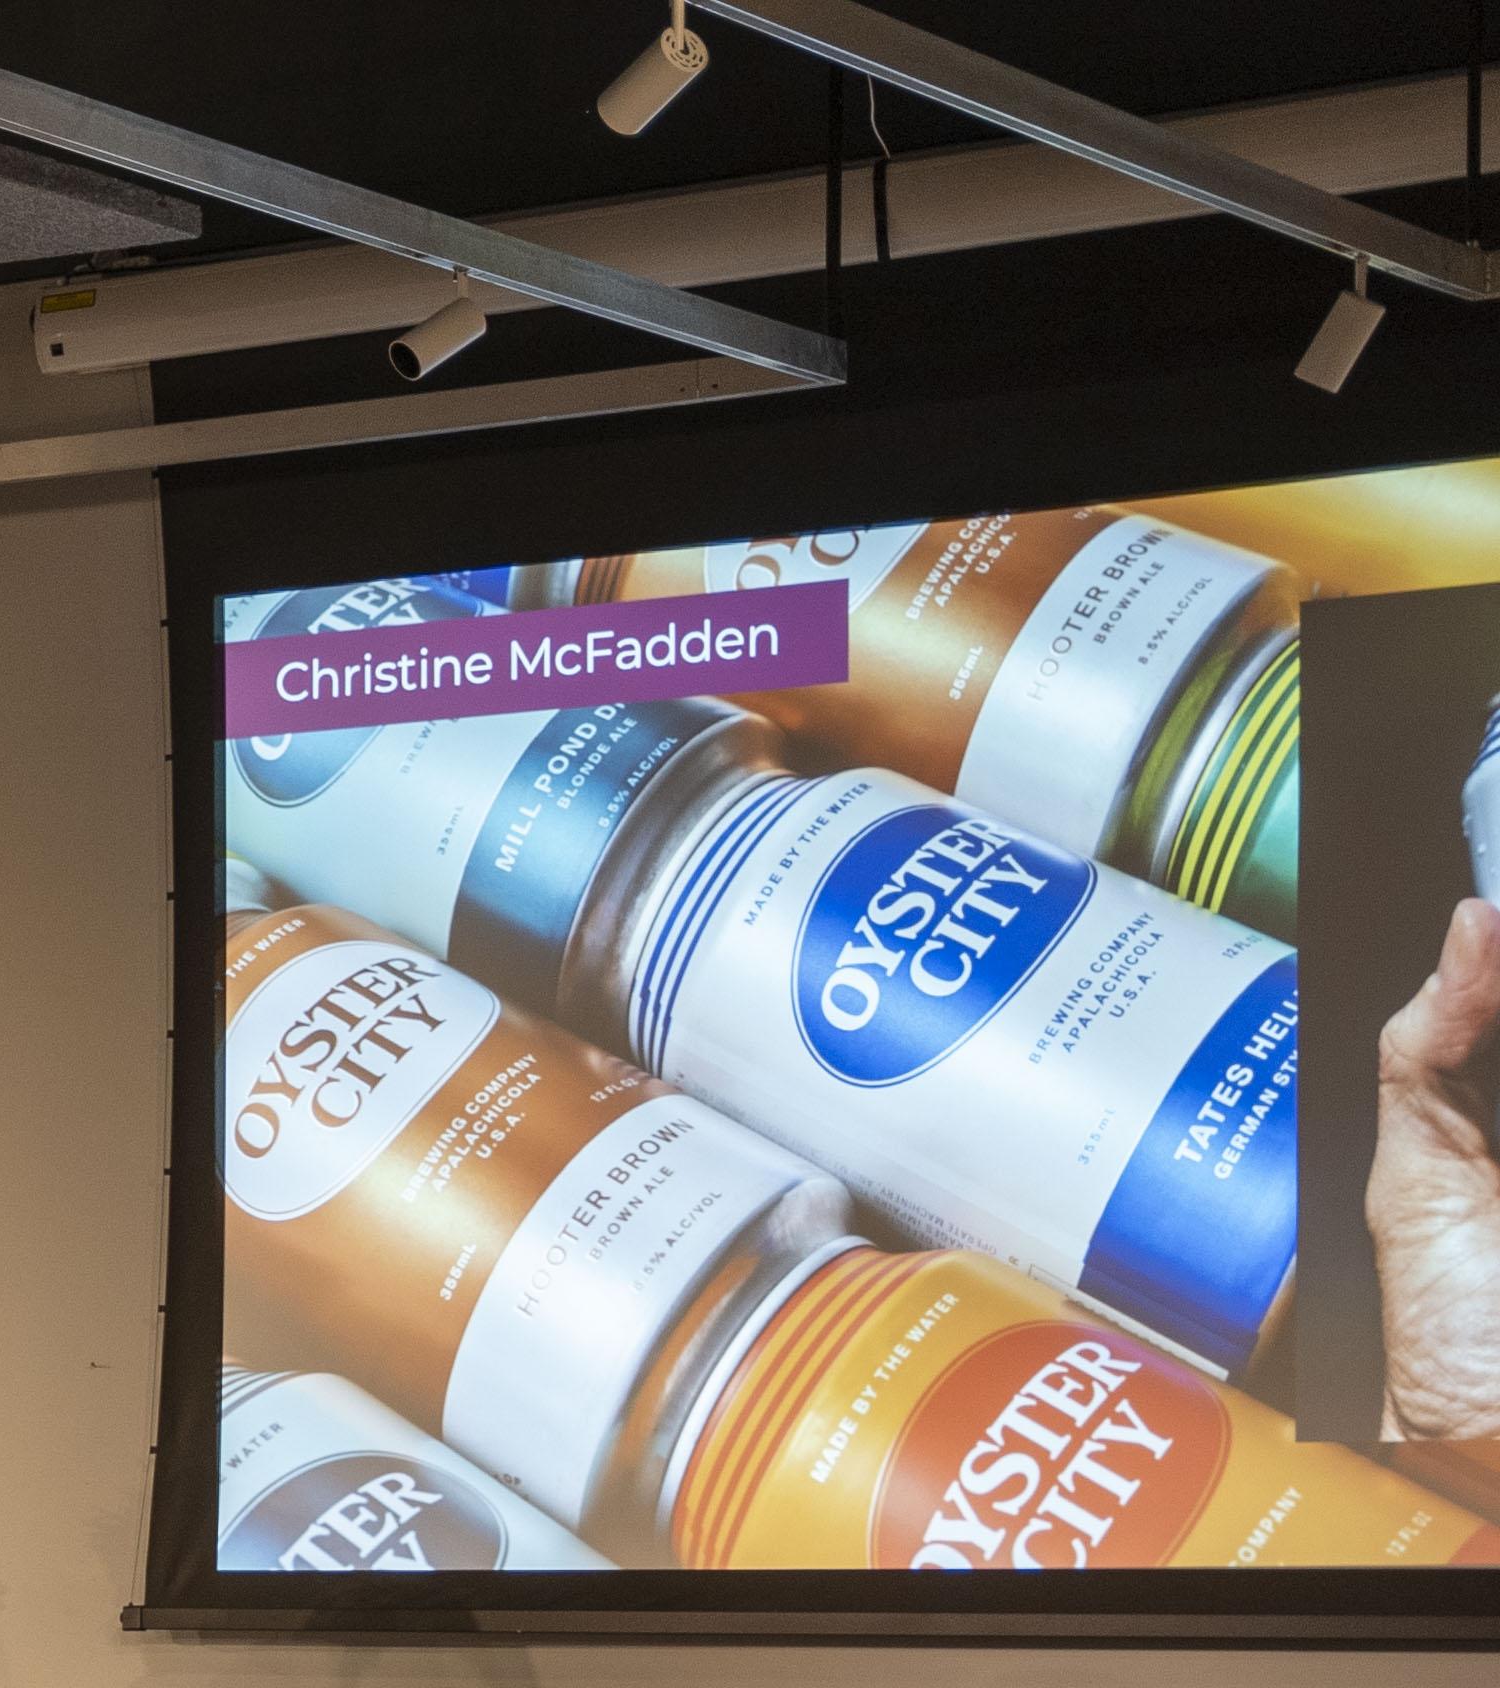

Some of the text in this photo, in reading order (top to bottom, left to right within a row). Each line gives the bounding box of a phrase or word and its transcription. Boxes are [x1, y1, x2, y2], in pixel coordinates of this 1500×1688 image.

[308, 578, 431, 635] TER
[1026, 528, 1174, 702] HOOTER BROWN
[1093, 560, 1166, 645] BROWN ALE
[276, 619, 780, 702] Christine McFadden
[495, 801, 542, 872] MILL
[534, 722, 597, 794] POND
[556, 716, 639, 810] BLONDE ALE
[627, 735, 680, 788] ALC/VOL
[743, 781, 873, 927] MADE BY THE WATER
[226, 918, 306, 979] THE WATER
[821, 817, 1014, 1032] OYSTER
[909, 853, 1049, 997] CITY
[1028, 911, 1155, 1066] BREWING COMPANY
[1061, 930, 1164, 1055] APALACHICOLA
[1109, 968, 1157, 1019] U.S.A.
[234, 957, 443, 1159] OYSTER
[311, 993, 447, 1128] CITY
[401, 1053, 538, 1204] BREWING COMPANY
[431, 1072, 541, 1194] APALACHICOLA
[475, 1111, 527, 1160] U.S.A.
[1173, 1063, 1255, 1163] TATES
[1213, 1087, 1280, 1179] GERMAN
[516, 1118, 695, 1319] HOOTER BROWN
[588, 1165, 675, 1262] BROWN ALE
[666, 1190, 723, 1248] ALC/VOL
[810, 1416, 859, 1484] MADE
[851, 1385, 878, 1416] BY
[874, 1341, 912, 1382] THE
[905, 1292, 960, 1344] WATER
[227, 1422, 285, 1470] WATER
[275, 1472, 444, 1571] TER
